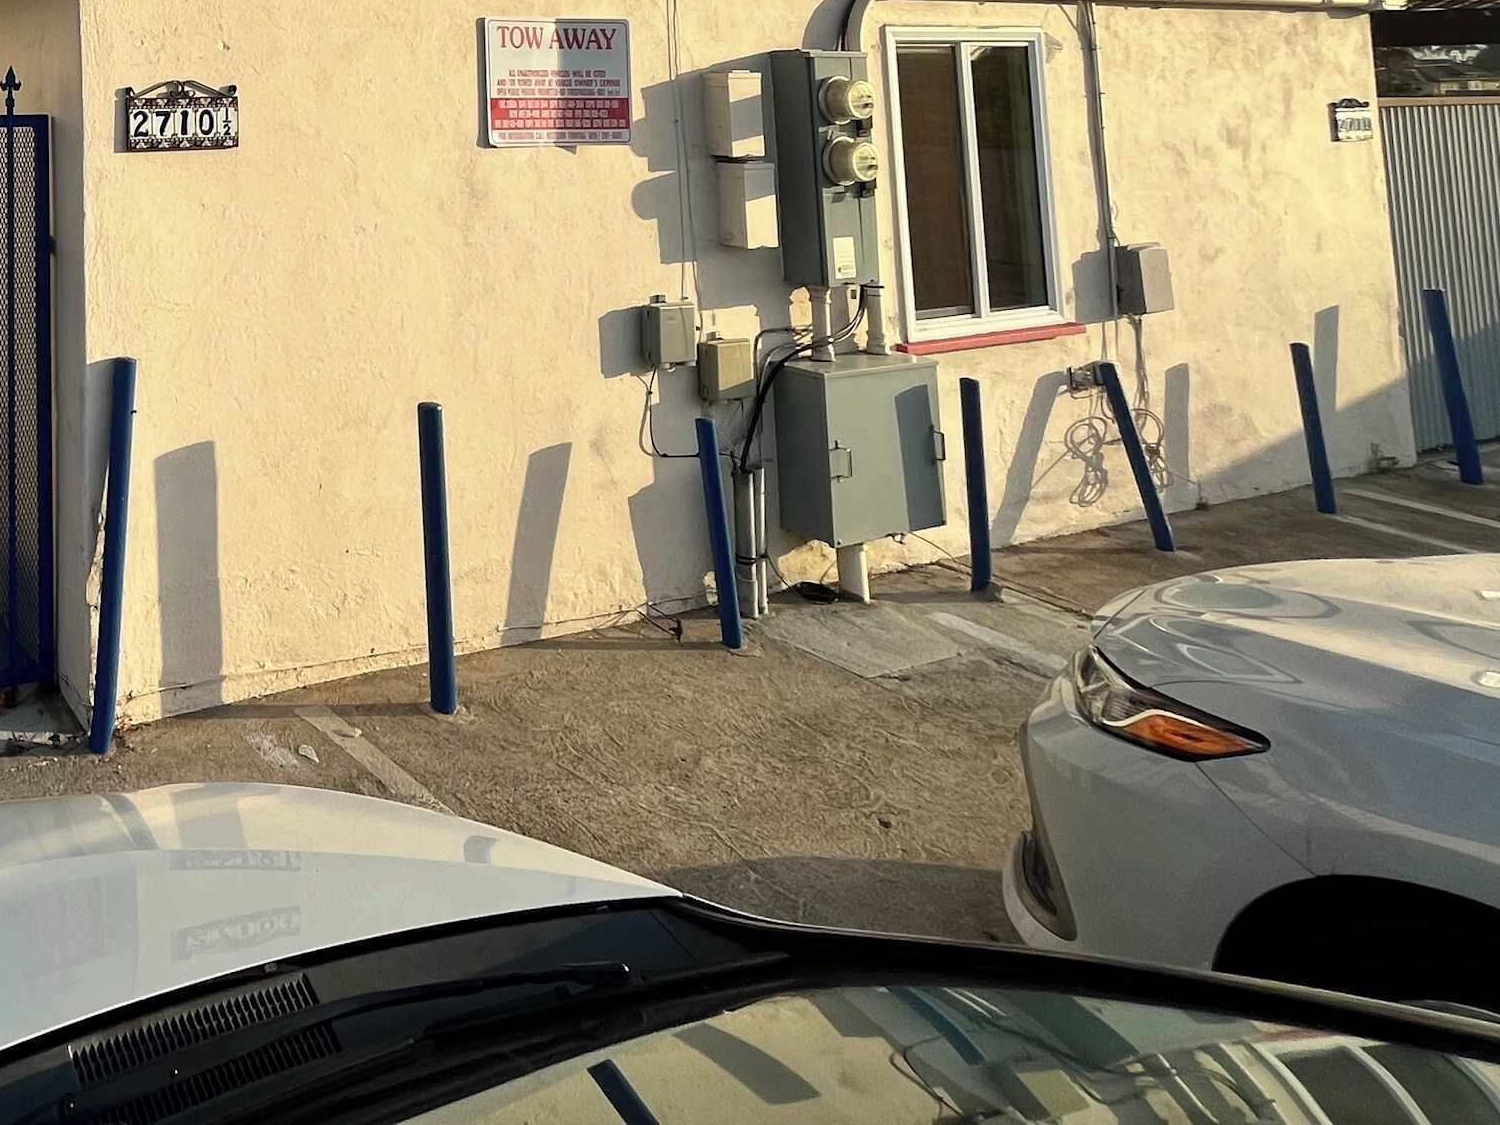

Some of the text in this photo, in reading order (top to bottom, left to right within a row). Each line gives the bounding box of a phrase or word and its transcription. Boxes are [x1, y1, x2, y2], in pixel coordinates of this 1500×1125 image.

[497, 26, 618, 50] TOW AWAY
[133, 110, 213, 137] 2710
